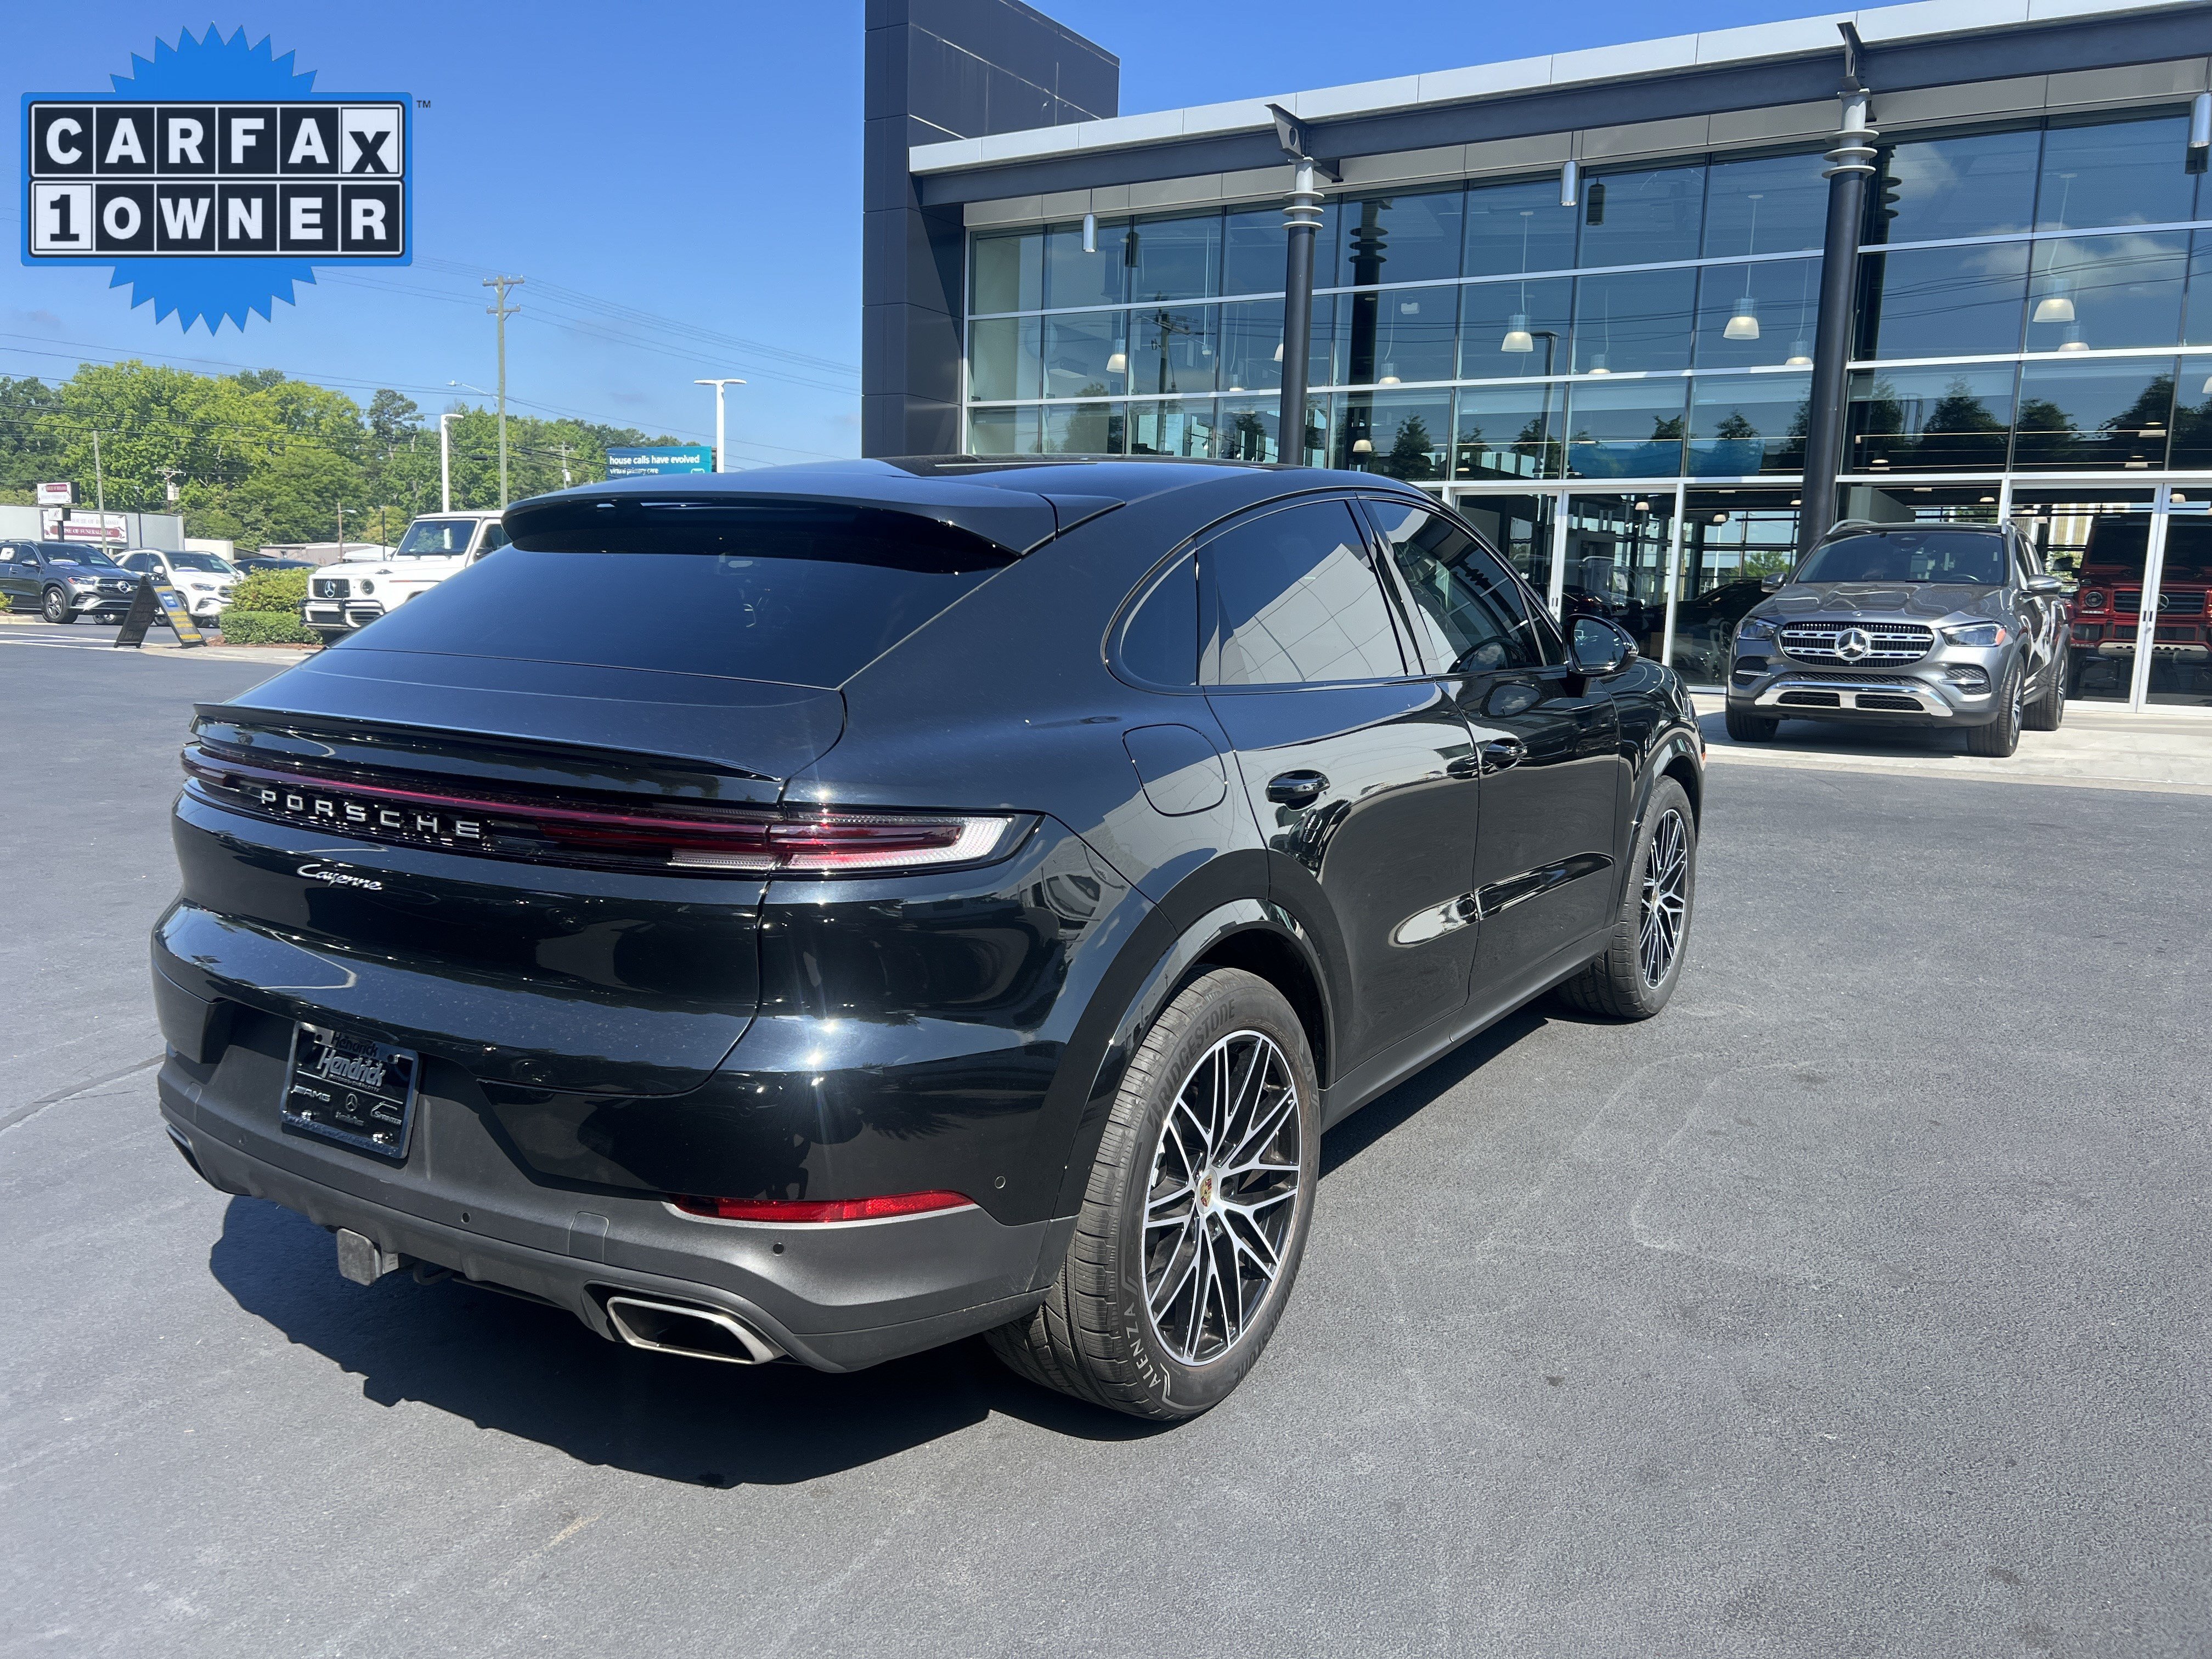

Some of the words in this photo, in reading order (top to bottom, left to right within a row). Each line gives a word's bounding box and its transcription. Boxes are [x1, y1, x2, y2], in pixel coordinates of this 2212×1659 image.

[610, 456, 631, 465] house
[633, 455, 650, 465] calls
[651, 455, 669, 464] have
[671, 454, 700, 464] evolved
[261, 789, 481, 839] PORSCHE
[297, 864, 382, 890] Cayenne
[317, 1047, 386, 1087] Hendrick
[1147, 998, 1236, 1133] BRIDGESTONE
[304, 1088, 331, 1102] AMG
[1124, 1302, 1161, 1388] ALENZA
